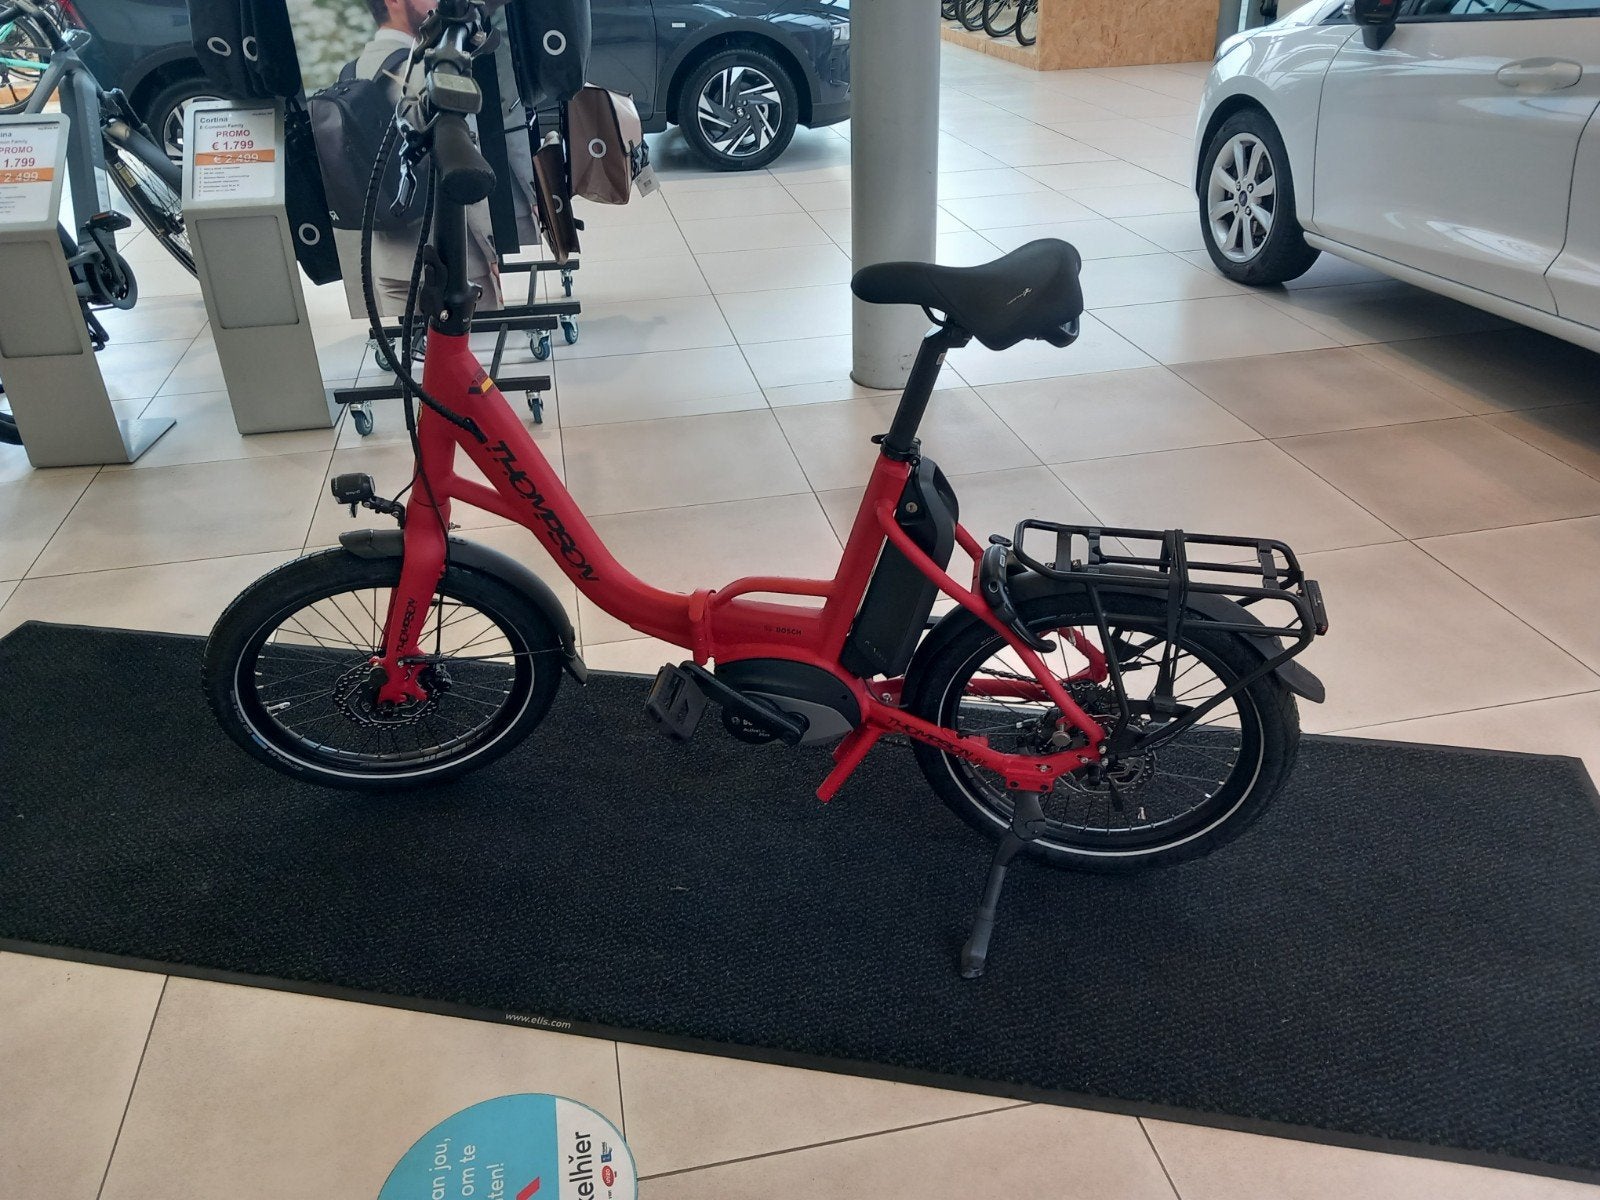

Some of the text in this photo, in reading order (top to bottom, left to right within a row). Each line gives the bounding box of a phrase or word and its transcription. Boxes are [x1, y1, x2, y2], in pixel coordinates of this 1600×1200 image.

[200, 116, 228, 124] Cortina
[216, 129, 251, 138] PROMO
[212, 140, 254, 151] € 1.799
[4, 157, 36, 168] 1.799
[225, 153, 259, 164] 2.499
[4, 171, 39, 183] 2.499
[487, 440, 599, 582] THOMPSON
[776, 626, 802, 636] BOSCH
[505, 1013, 571, 1029] www.elis.com
[428, 1138, 452, 1172] jou,
[459, 1145, 476, 1196] om te
